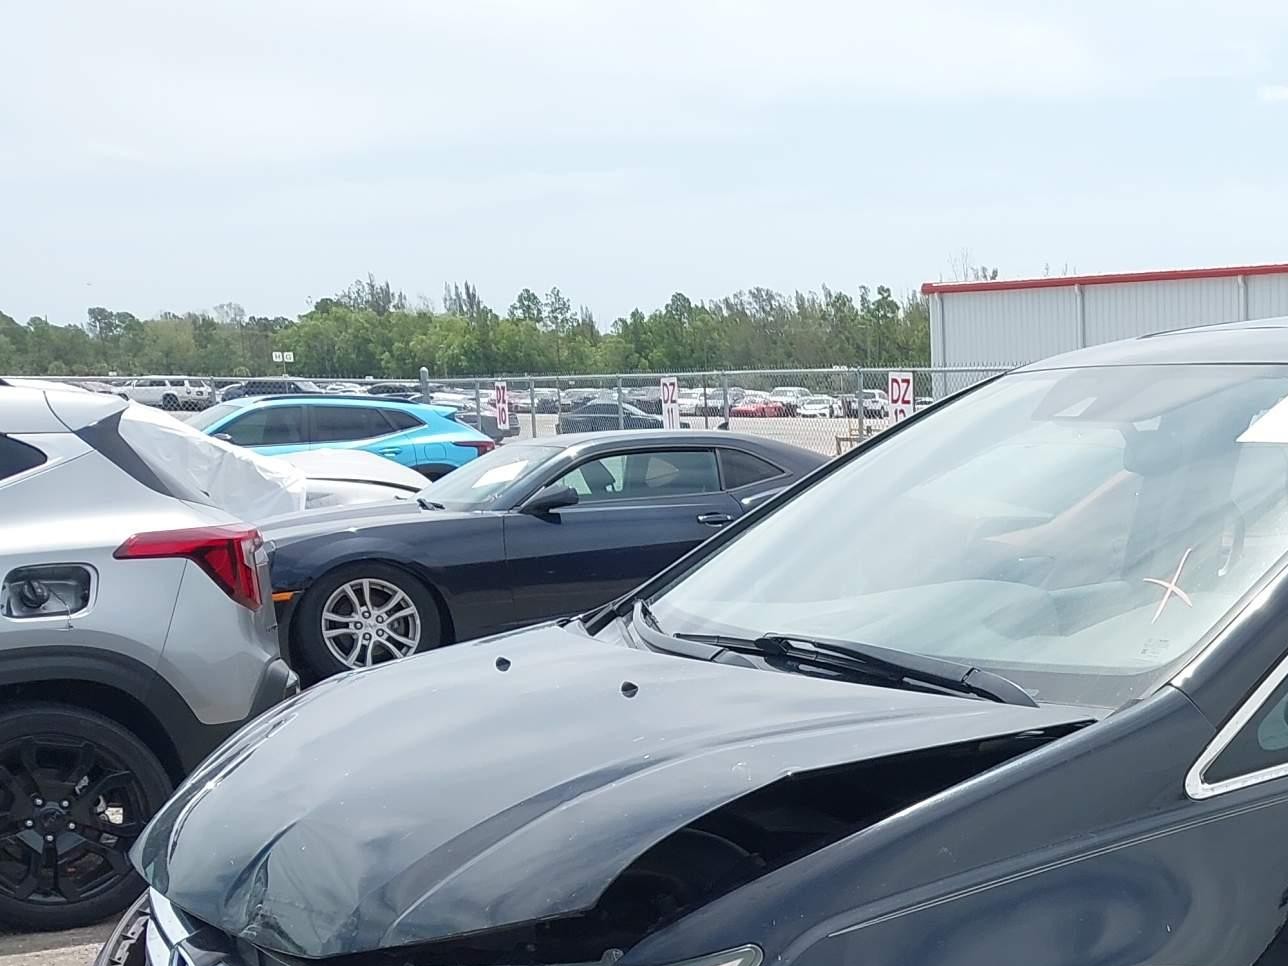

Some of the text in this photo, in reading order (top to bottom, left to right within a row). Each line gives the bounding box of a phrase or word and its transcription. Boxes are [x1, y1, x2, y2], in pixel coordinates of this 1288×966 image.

[496, 385, 506, 404] DZ
[662, 382, 677, 404] DZ
[891, 378, 911, 405] DZ
[498, 405, 507, 425] 10
[667, 407, 676, 429] 11
